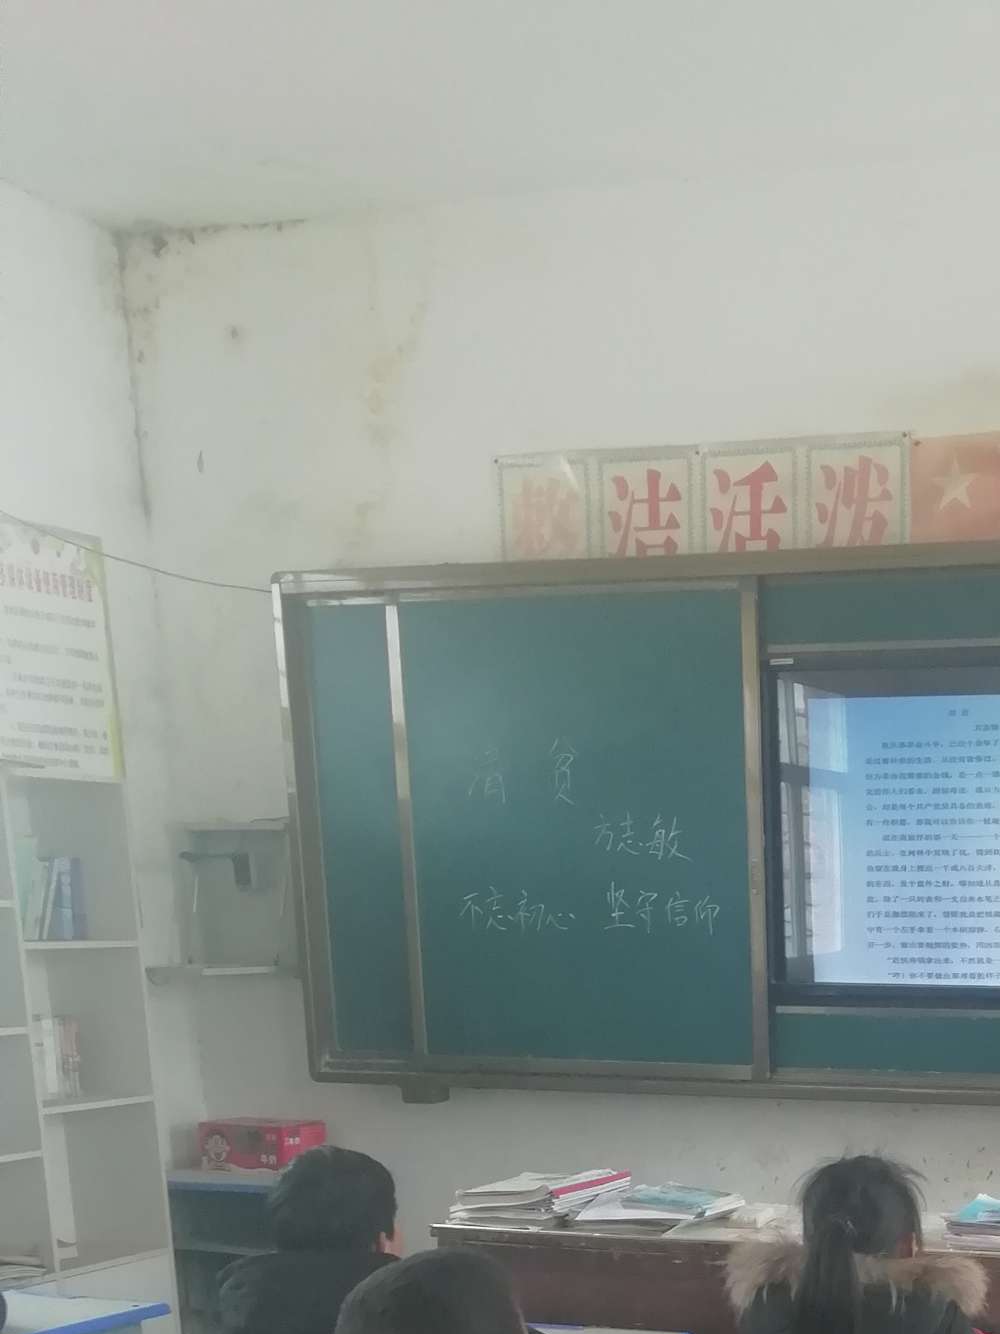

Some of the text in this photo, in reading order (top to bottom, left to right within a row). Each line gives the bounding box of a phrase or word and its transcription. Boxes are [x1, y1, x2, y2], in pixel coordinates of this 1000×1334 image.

[593, 811, 693, 862] 方志敏
[603, 881, 721, 936] 坚守信仰
